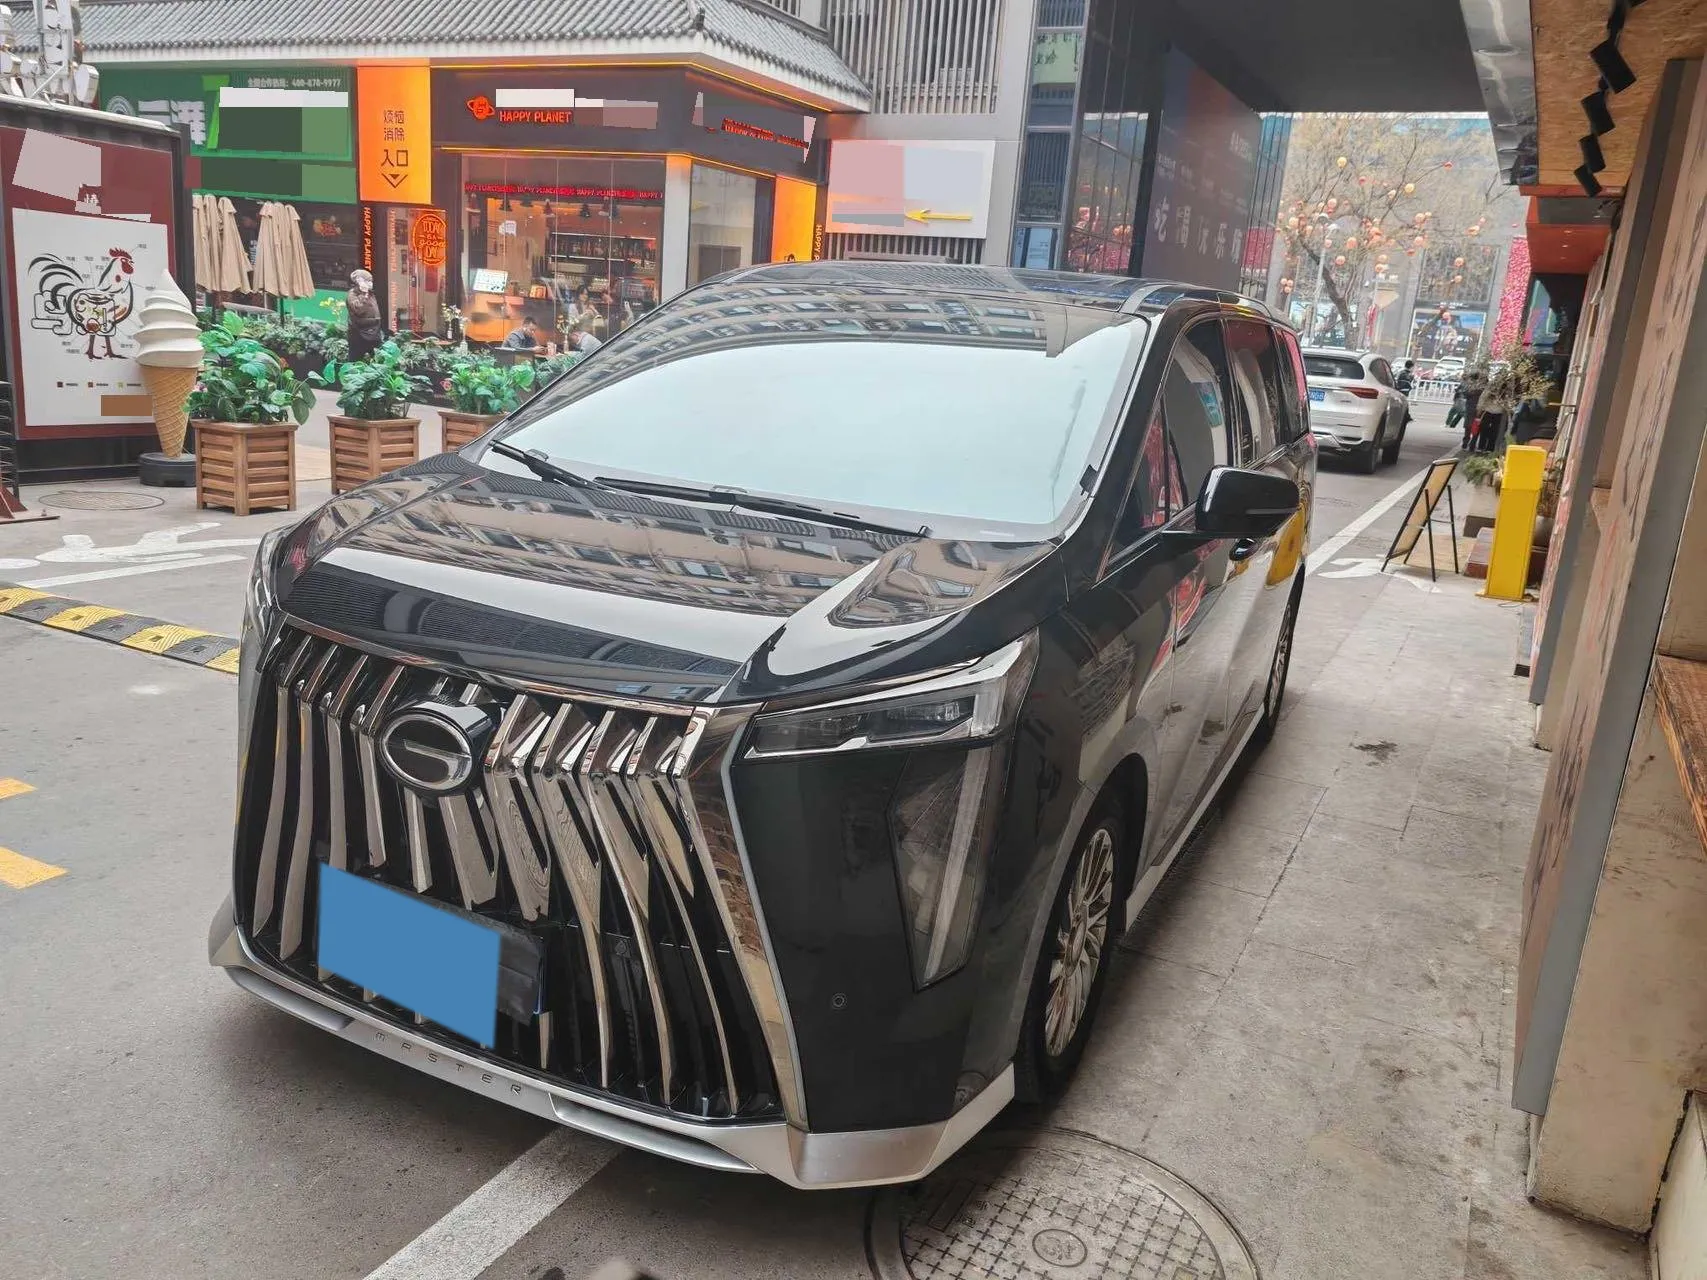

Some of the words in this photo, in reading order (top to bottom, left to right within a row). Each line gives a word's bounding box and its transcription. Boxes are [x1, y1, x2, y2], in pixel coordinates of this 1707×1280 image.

[384, 110, 404, 124] 烦恼
[499, 110, 531, 123] HAPPY
[534, 111, 572, 123] PLANET
[384, 127, 404, 142] 消除
[381, 149, 408, 167] 入口
[363, 207, 371, 236] HAPPY
[814, 224, 823, 253] HAPPY
[364, 238, 372, 271] PLANET
[375, 1032, 521, 1095] MASTER
